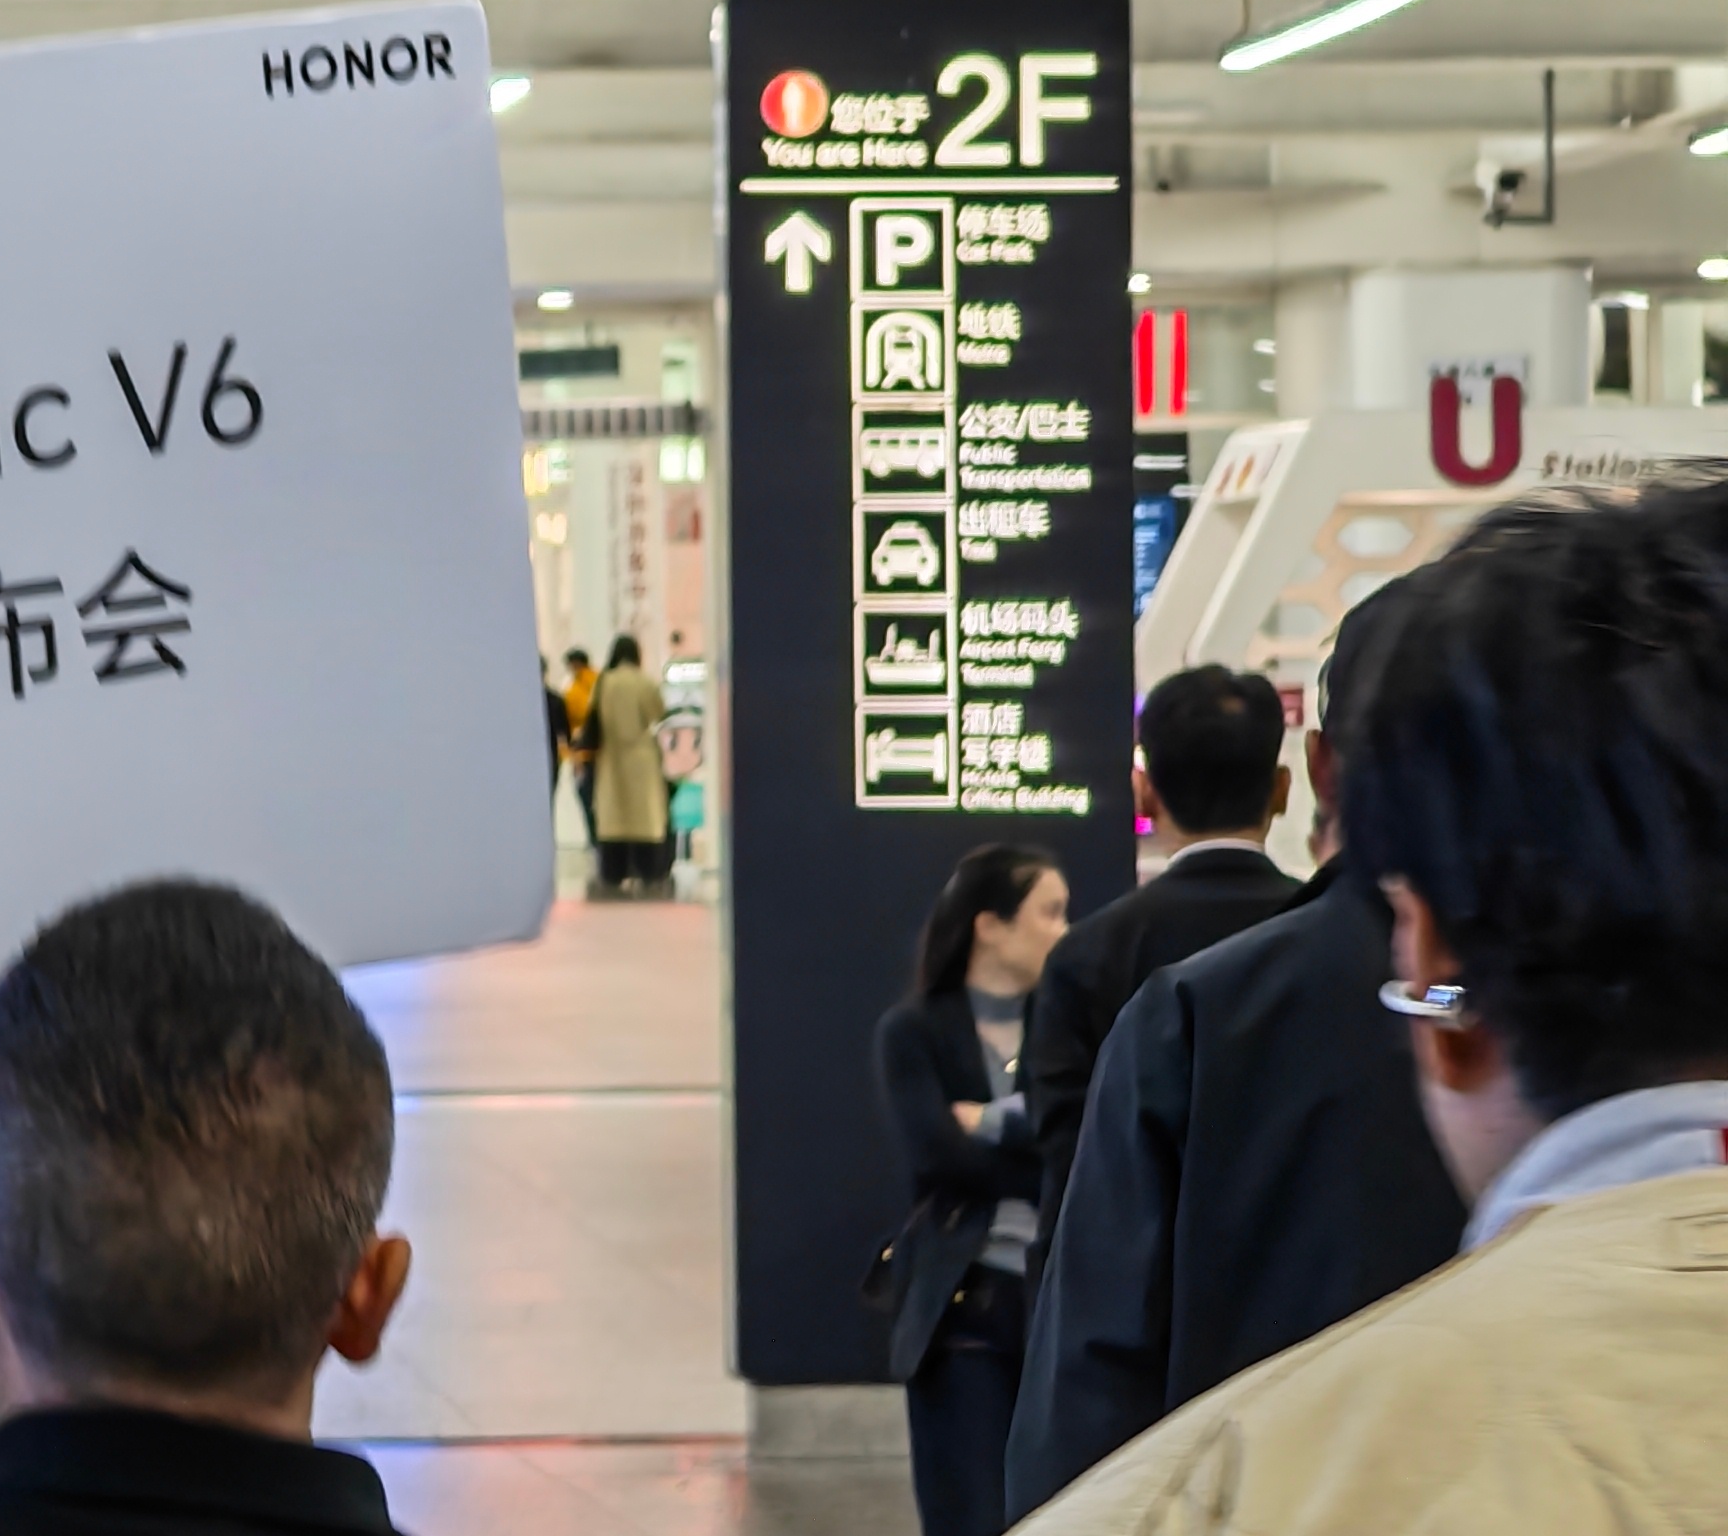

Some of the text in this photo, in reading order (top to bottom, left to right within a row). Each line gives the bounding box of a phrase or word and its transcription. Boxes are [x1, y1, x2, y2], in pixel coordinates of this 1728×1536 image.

[261, 31, 456, 100] HONOR
[830, 94, 930, 134] 您位于
[935, 51, 1098, 167] 2F
[761, 138, 929, 167] You are Here
[956, 203, 1051, 242] 停车场
[875, 214, 935, 286] P
[958, 303, 1021, 340] 地铁
[108, 335, 264, 457] V6
[959, 400, 1092, 442] 公交/巴士
[1430, 375, 1522, 487] U
[959, 442, 1018, 465] Public
[960, 465, 1091, 492] Transportation
[959, 500, 1052, 540] 出租车
[960, 600, 1079, 639] 机场码头
[960, 637, 1016, 661] Airport
[962, 701, 1024, 737] 酒店
[961, 735, 1052, 773] 写字楼
[1015, 786, 1090, 816] Building
